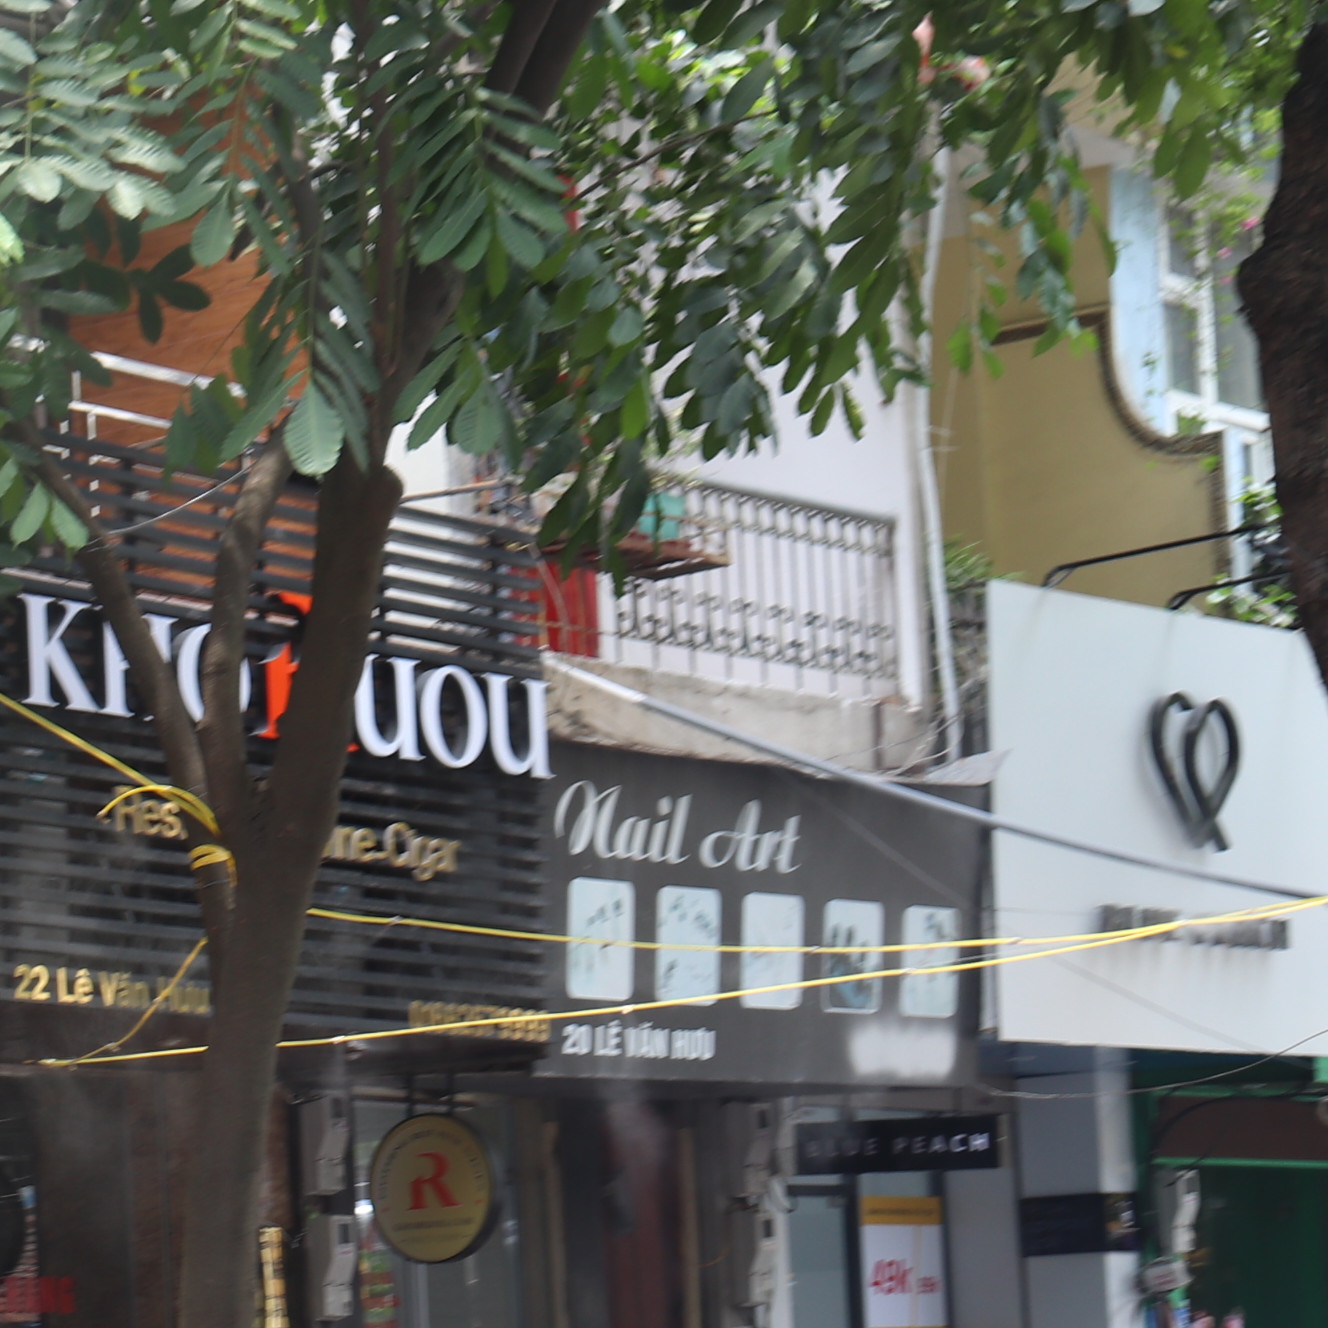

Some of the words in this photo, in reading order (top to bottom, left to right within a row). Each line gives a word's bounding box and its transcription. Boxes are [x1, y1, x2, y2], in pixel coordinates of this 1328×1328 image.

[553, 779, 694, 865] Nail
[698, 799, 802, 875] Art
[13, 963, 51, 1001] 22
[55, 966, 94, 1005] Lê
[560, 1022, 593, 1056] 20
[893, 1131, 992, 1155] PEACH
